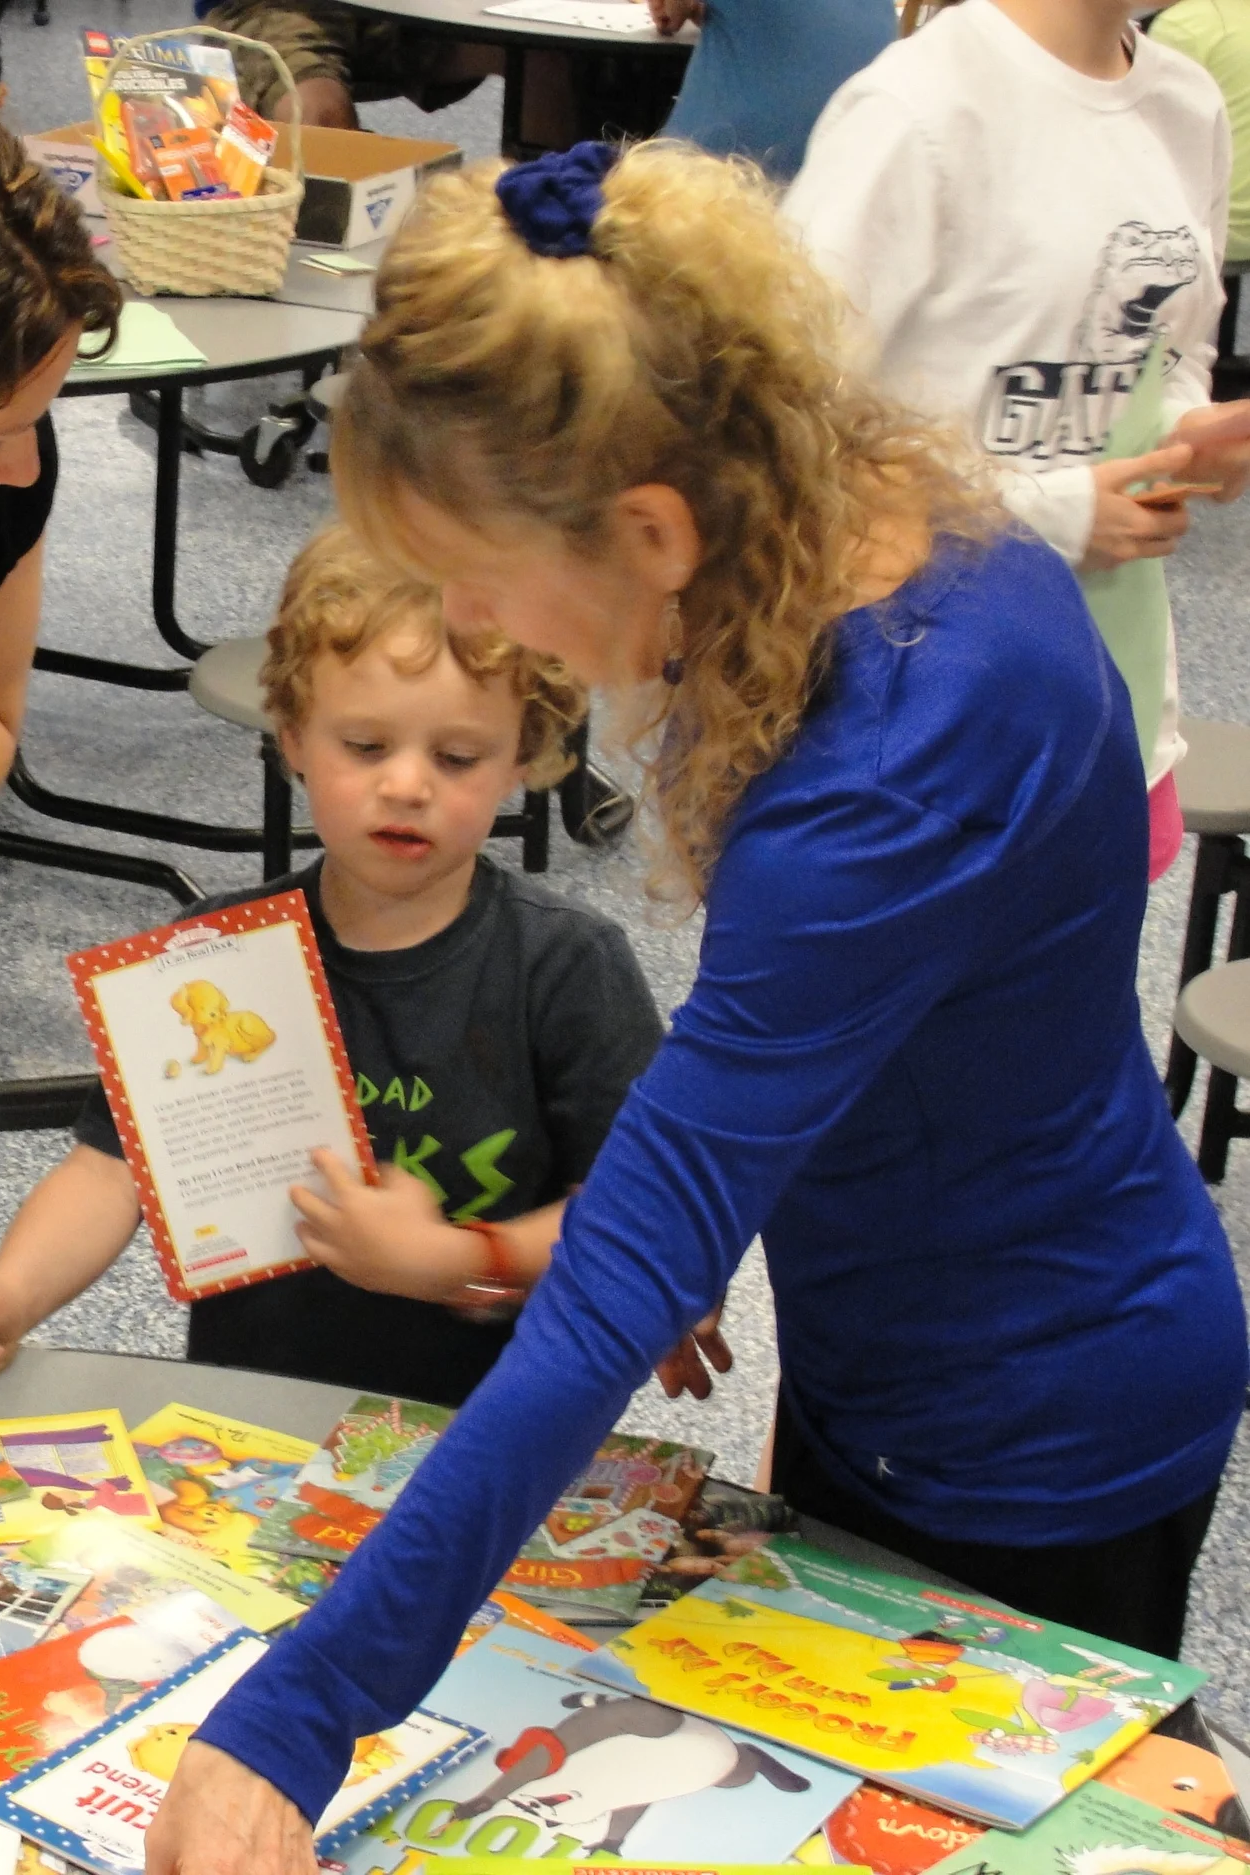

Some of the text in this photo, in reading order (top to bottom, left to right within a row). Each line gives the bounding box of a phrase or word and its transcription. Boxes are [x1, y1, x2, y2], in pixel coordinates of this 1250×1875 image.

[981, 361, 1140, 458] GAT
[357, 1072, 435, 1113] DAD
[510, 1563, 583, 1586] Gin
